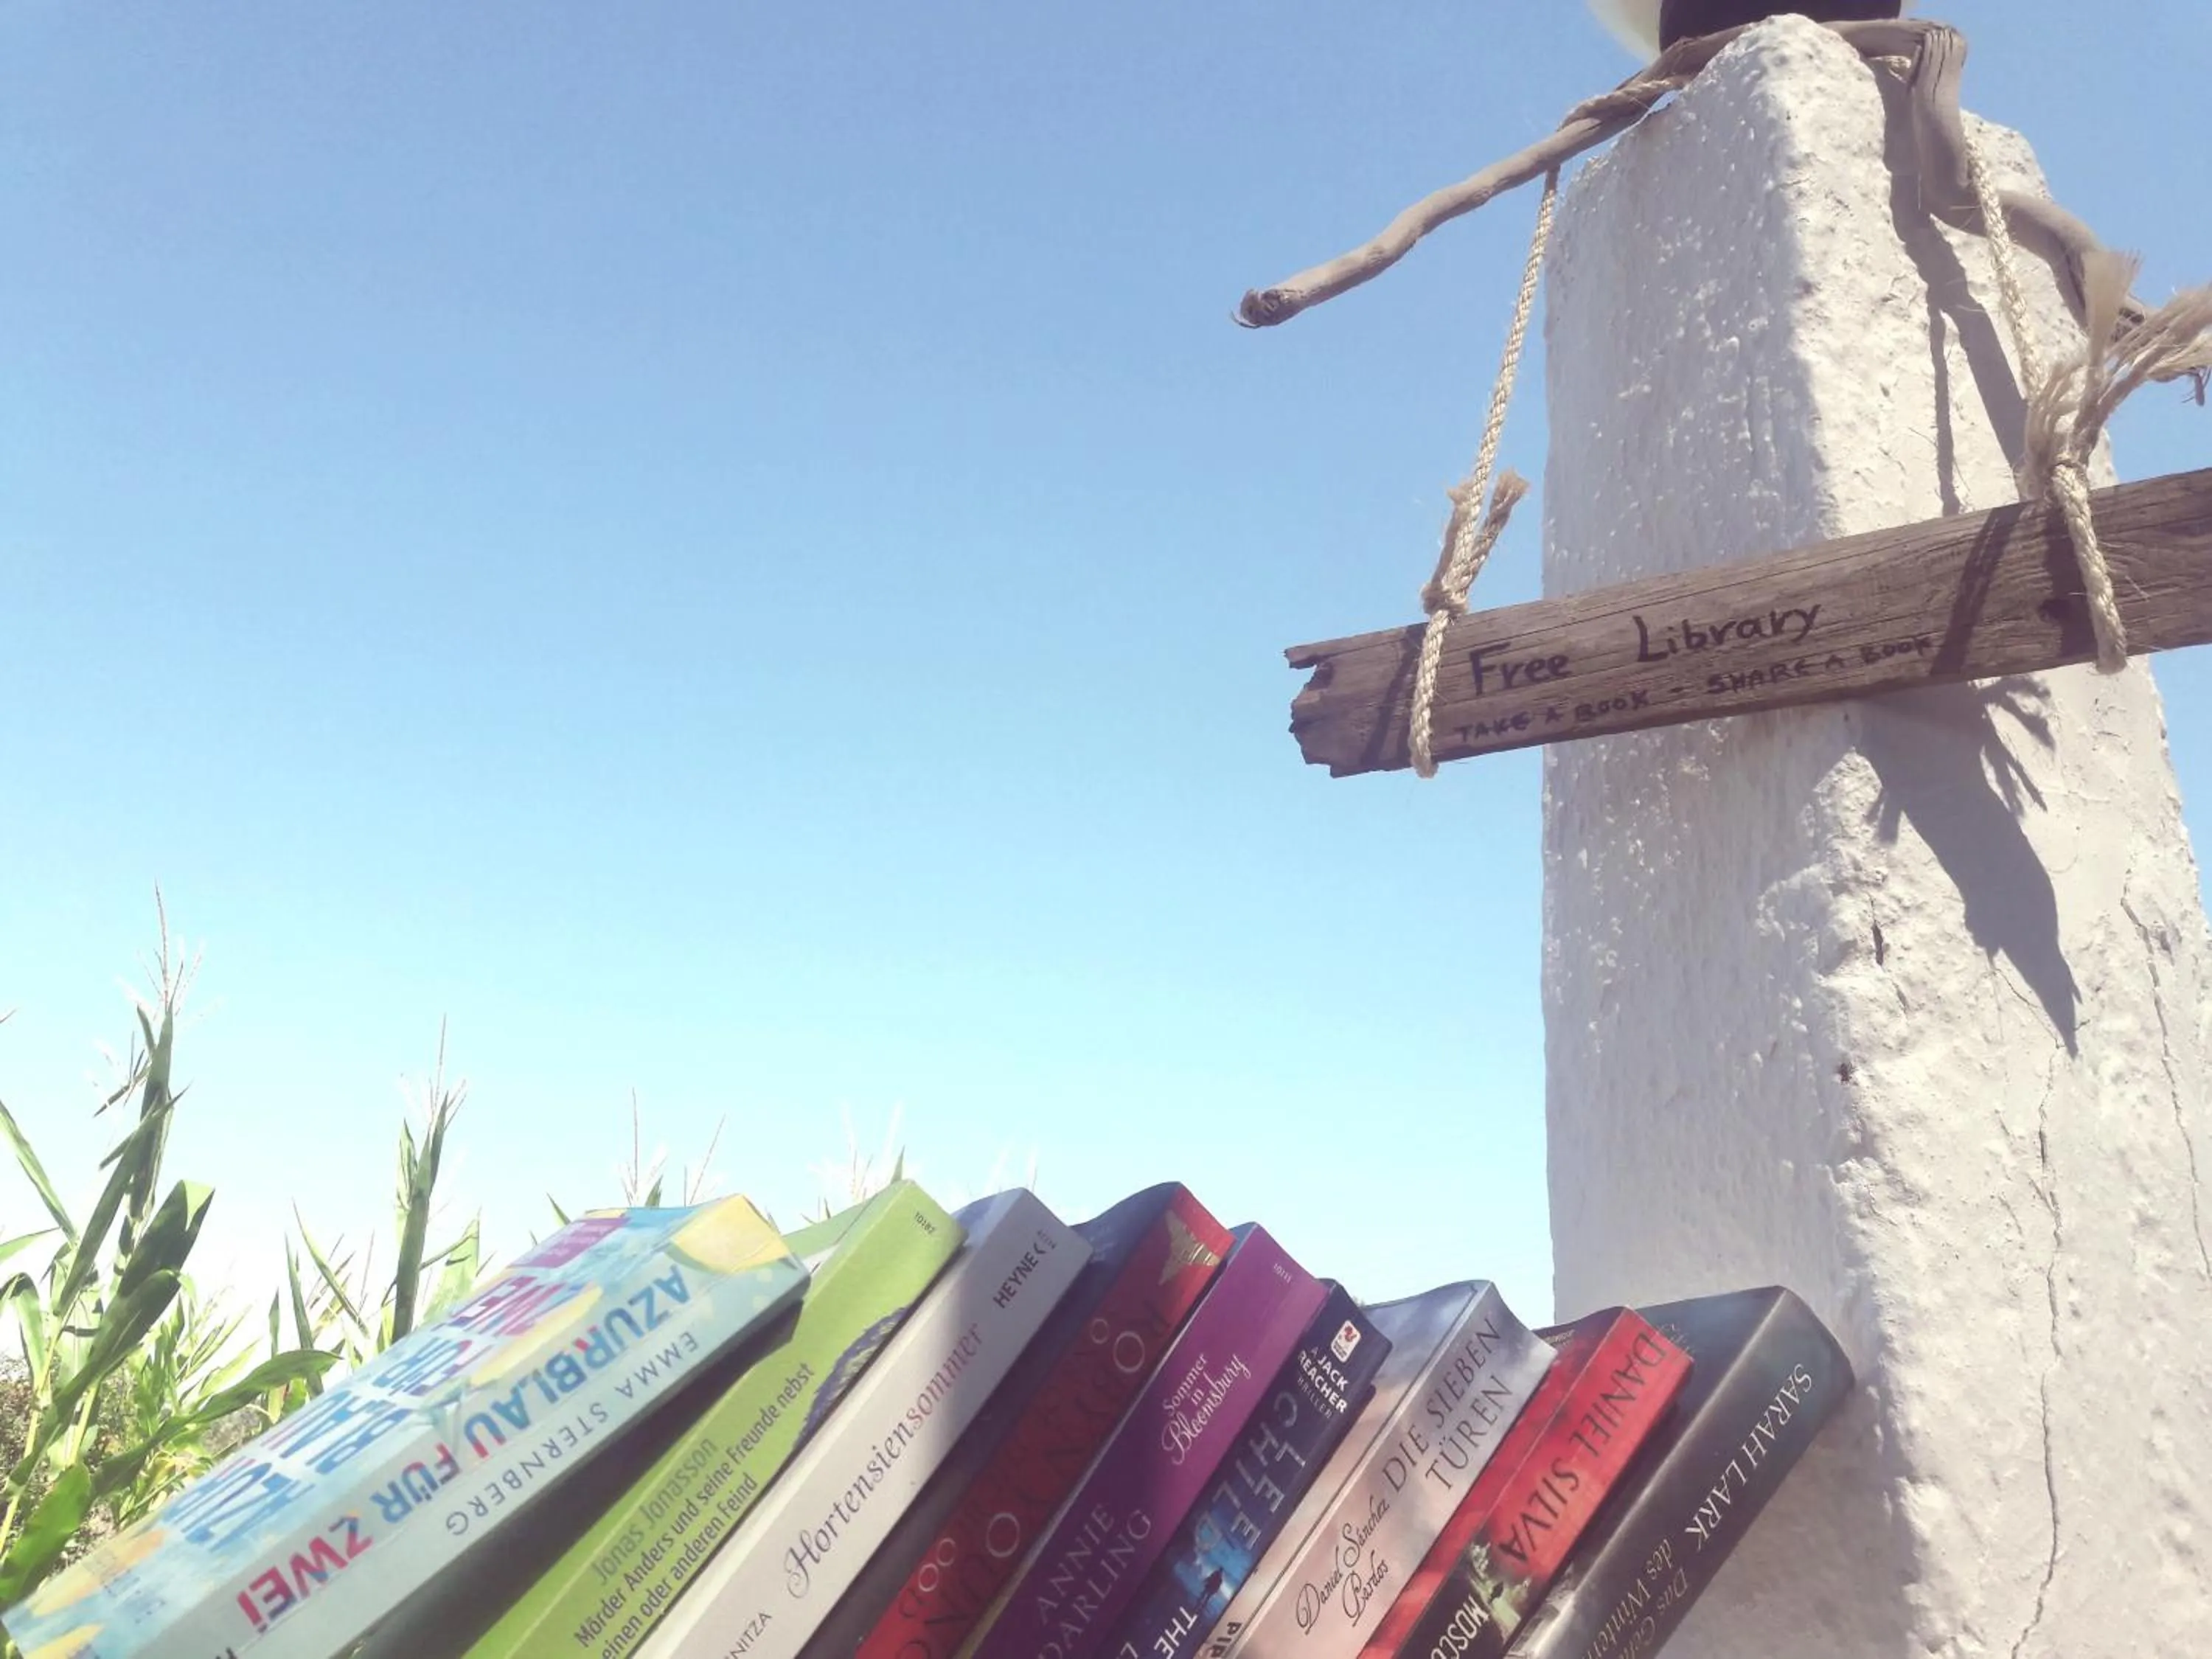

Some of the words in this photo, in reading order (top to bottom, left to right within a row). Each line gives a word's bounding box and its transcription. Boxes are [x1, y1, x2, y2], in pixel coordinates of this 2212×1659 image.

[1454, 710, 1532, 740] TAKE
[1545, 705, 1564, 723] A
[1576, 689, 1651, 723] BOOK
[1707, 662, 1820, 695] SHARE
[1825, 654, 1846, 671] A
[1860, 635, 1933, 667] BOOK
[1470, 643, 1569, 695] Free
[1632, 603, 1821, 663] Library
[992, 1251, 1038, 1308] HEYNE
[463, 1265, 692, 1459] AZURBLAU
[616, 1331, 698, 1398] EMMA
[1161, 1352, 1210, 1417] Sommer
[1161, 1353, 1251, 1466] Bloomsbury
[1190, 1385, 1206, 1406] in
[1298, 1349, 1348, 1413] REACHER
[1318, 1354, 1349, 1392] JACK
[1382, 1427, 1429, 1492] DIE
[1426, 1317, 1500, 1427] SIEBEN
[1568, 1331, 1665, 1456] DANIEL
[785, 1323, 984, 1599] Hortensiensommer
[1425, 1372, 1513, 1491] TÜREN
[1741, 1363, 1812, 1468] SARAH
[371, 1443, 460, 1523] FÜR
[445, 1405, 608, 1537] STERNBERG
[574, 1587, 627, 1648] Mörder
[624, 1536, 675, 1592] Anders
[673, 1500, 700, 1535] und
[697, 1458, 734, 1499] seine
[728, 1404, 780, 1464] Freunde
[773, 1363, 816, 1411] nebst
[591, 1525, 644, 1585] Jonas
[639, 1436, 718, 1530] Jonasson
[1192, 1389, 1298, 1550] CHILD
[1229, 1438, 1307, 1550] LEE
[1498, 1455, 1579, 1562] SILVA
[1684, 1461, 1746, 1550] LARK
[236, 1510, 375, 1633] ZWEI
[602, 1615, 643, 1659] einen
[640, 1576, 672, 1617] oder
[670, 1517, 723, 1580] anderen
[715, 1472, 759, 1525] Feind
[1037, 1503, 1114, 1624] ANNIE
[1295, 1548, 1349, 1635] Daniel
[1341, 1493, 1390, 1565] Sánchez
[1340, 1558, 1390, 1628] Pardos
[1646, 1539, 1671, 1581] des
[1657, 1568, 1688, 1615] Das
[723, 1611, 773, 1659] NITZA
[1153, 1606, 1197, 1659] THE
[1582, 1578, 1651, 1659] Winter
